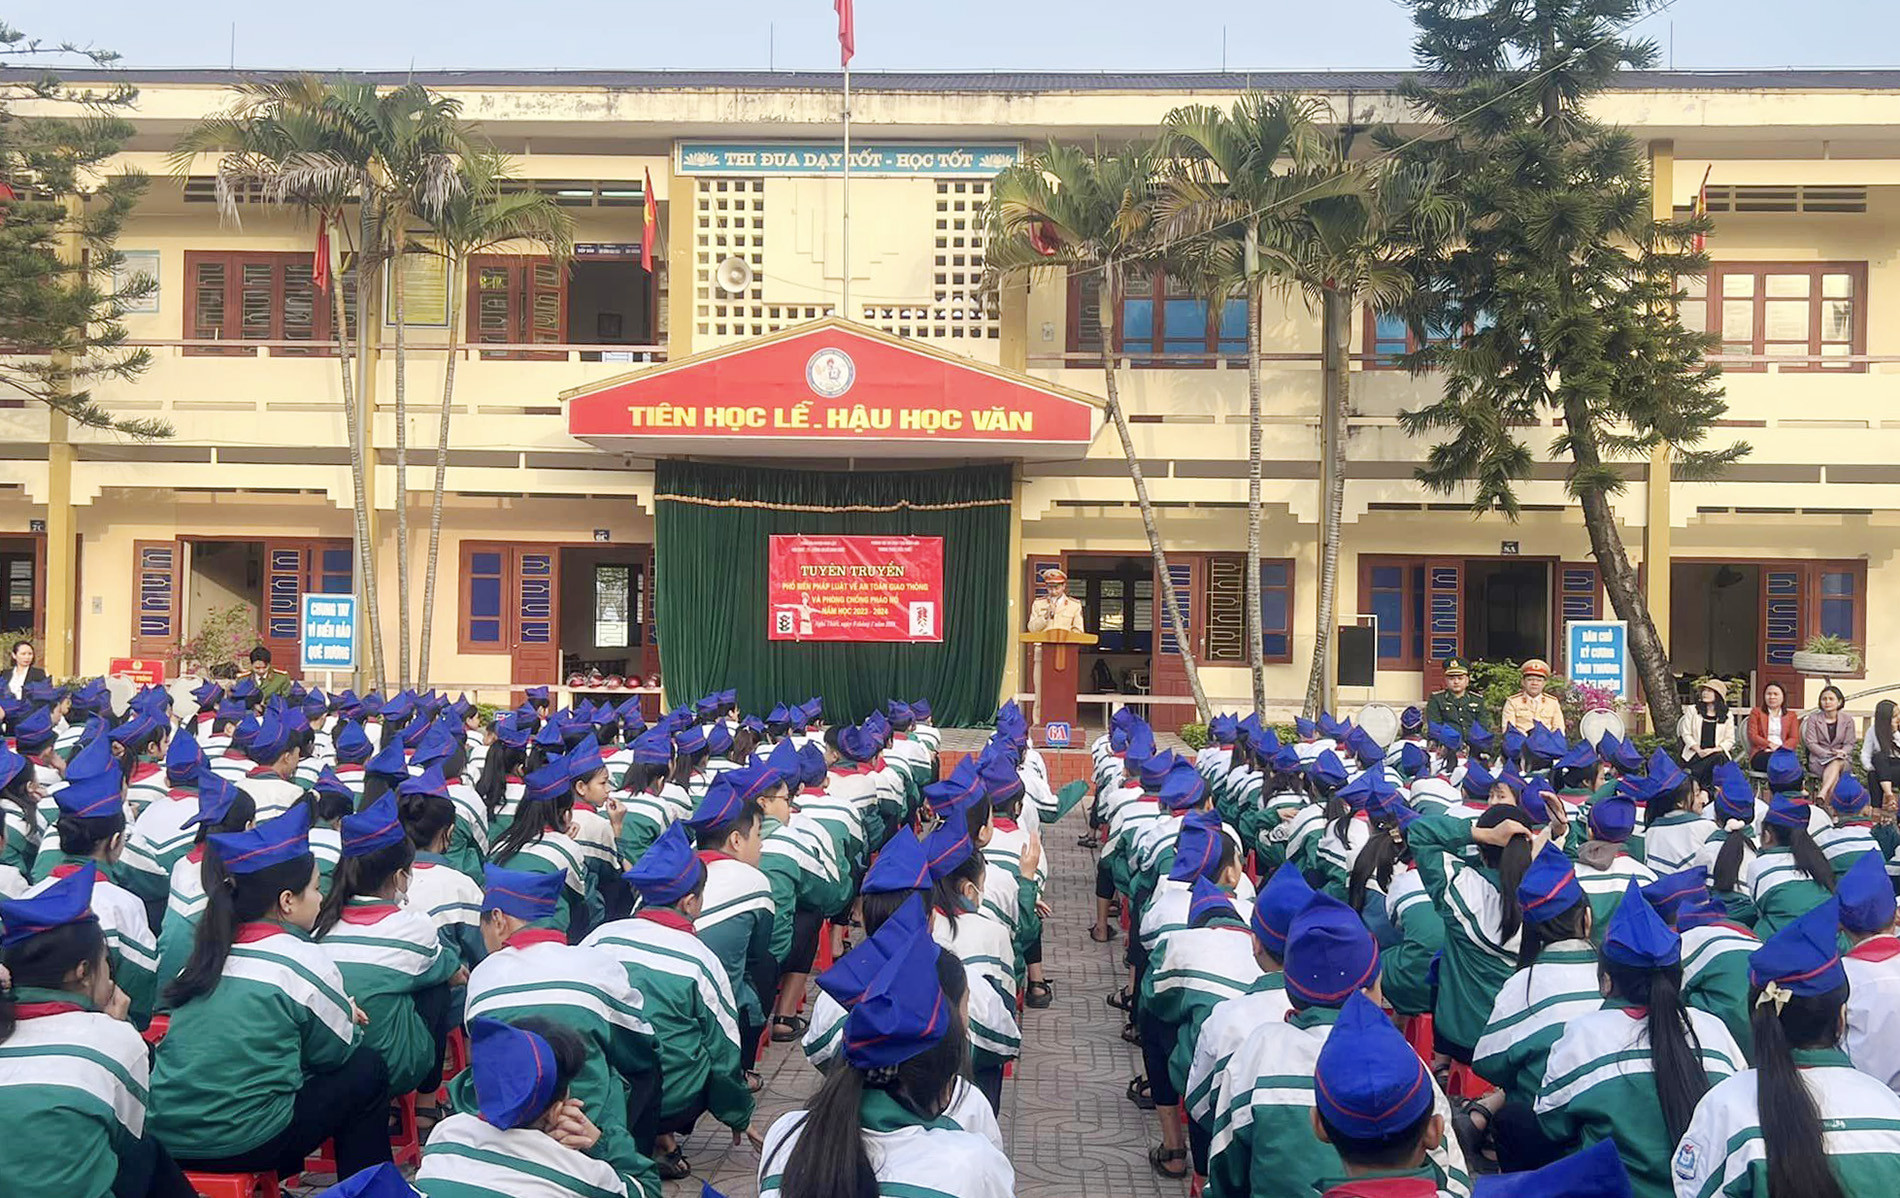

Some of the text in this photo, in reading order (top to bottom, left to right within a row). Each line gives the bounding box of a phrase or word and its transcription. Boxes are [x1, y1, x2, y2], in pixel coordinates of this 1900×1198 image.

[724, 152, 757, 167] THI
[760, 152, 800, 167] ĐUA
[803, 152, 843, 171] DẠY
[848, 148, 882, 167] TỐT
[896, 153, 934, 171] HỌC
[938, 148, 973, 168] TỐT
[628, 402, 697, 427] TIÊN
[703, 406, 767, 431] HỌC
[773, 400, 814, 429] LỄ
[826, 404, 892, 433] HẬU
[899, 408, 963, 434] HỌC
[970, 406, 1033, 432] VĂN
[801, 562, 846, 577] TUYÊN
[813, 580, 830, 590] PHÁP
[859, 583, 869, 591] AN
[888, 583, 905, 591] GIAO
[906, 582, 929, 591] THÔNG
[846, 594, 869, 604] CHỐNG
[838, 607, 853, 616] HỌC
[1048, 725, 1067, 741] 6A
